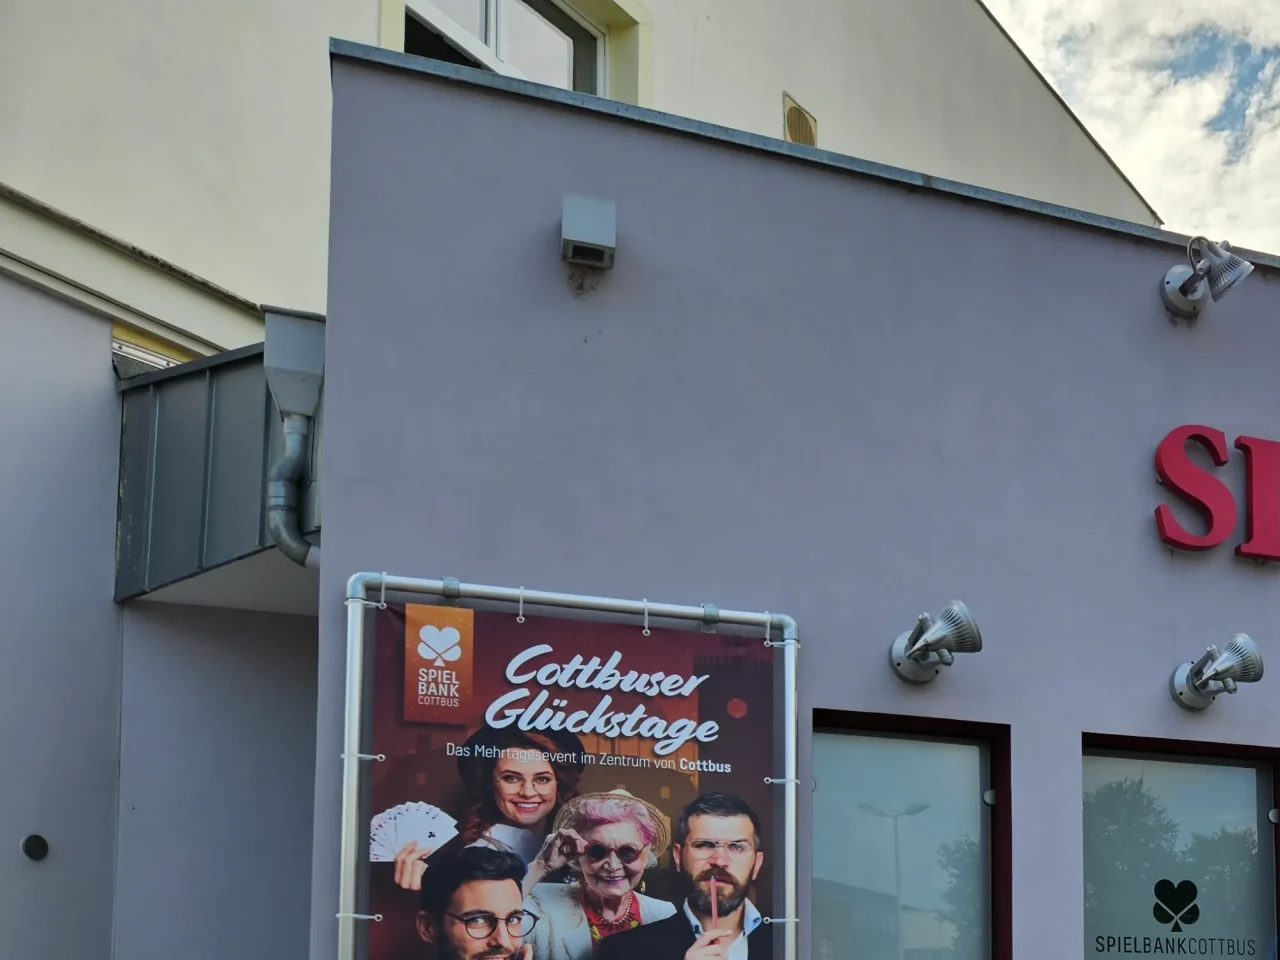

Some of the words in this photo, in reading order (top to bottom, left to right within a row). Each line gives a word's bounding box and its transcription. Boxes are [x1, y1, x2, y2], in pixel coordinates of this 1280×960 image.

[418, 668, 460, 684] SPIEL
[505, 643, 711, 697] Cottbuser
[418, 681, 460, 697] BANK
[417, 695, 460, 707] COTTBUS
[484, 687, 721, 756] Glückstage
[446, 742, 471, 757] Das
[474, 744, 577, 764] Mehrtagesevent
[580, 752, 596, 765] im
[599, 752, 651, 768] Zentrum
[653, 758, 676, 770] von
[680, 757, 732, 773] Cottbus
[1095, 935, 1256, 956] SPIELBANKCOTTBUS
